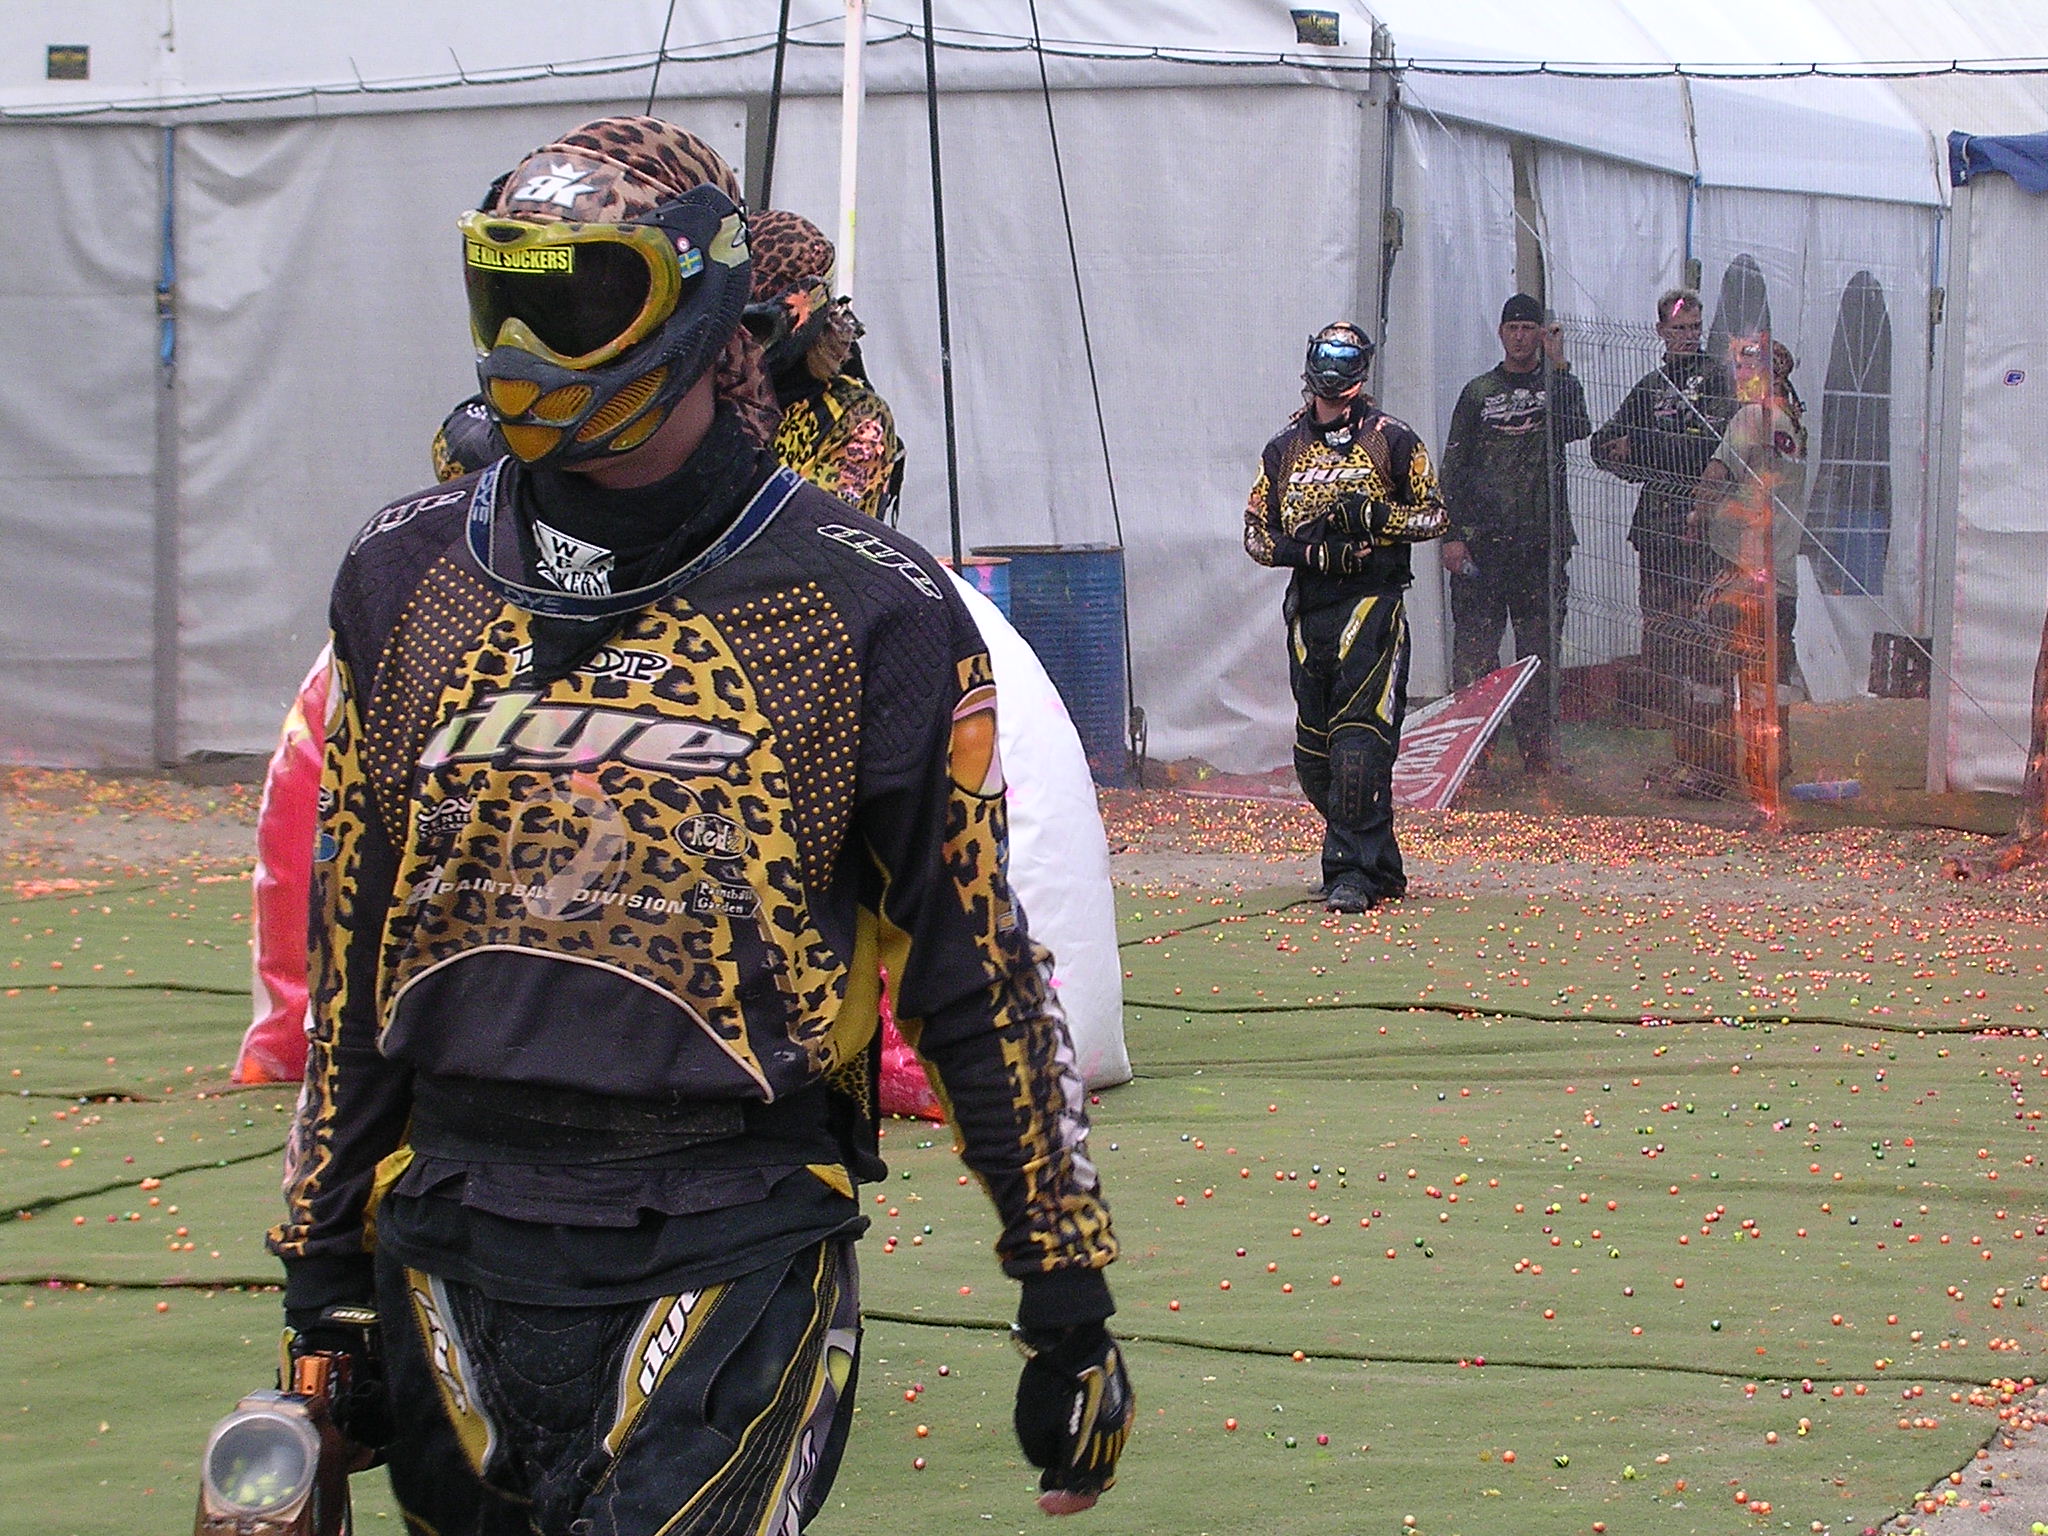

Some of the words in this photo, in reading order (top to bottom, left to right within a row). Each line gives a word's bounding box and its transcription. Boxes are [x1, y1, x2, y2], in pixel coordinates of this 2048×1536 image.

[419, 691, 754, 771] dye
[438, 876, 557, 901] PAINTBALL
[571, 887, 688, 915] DIVISION
